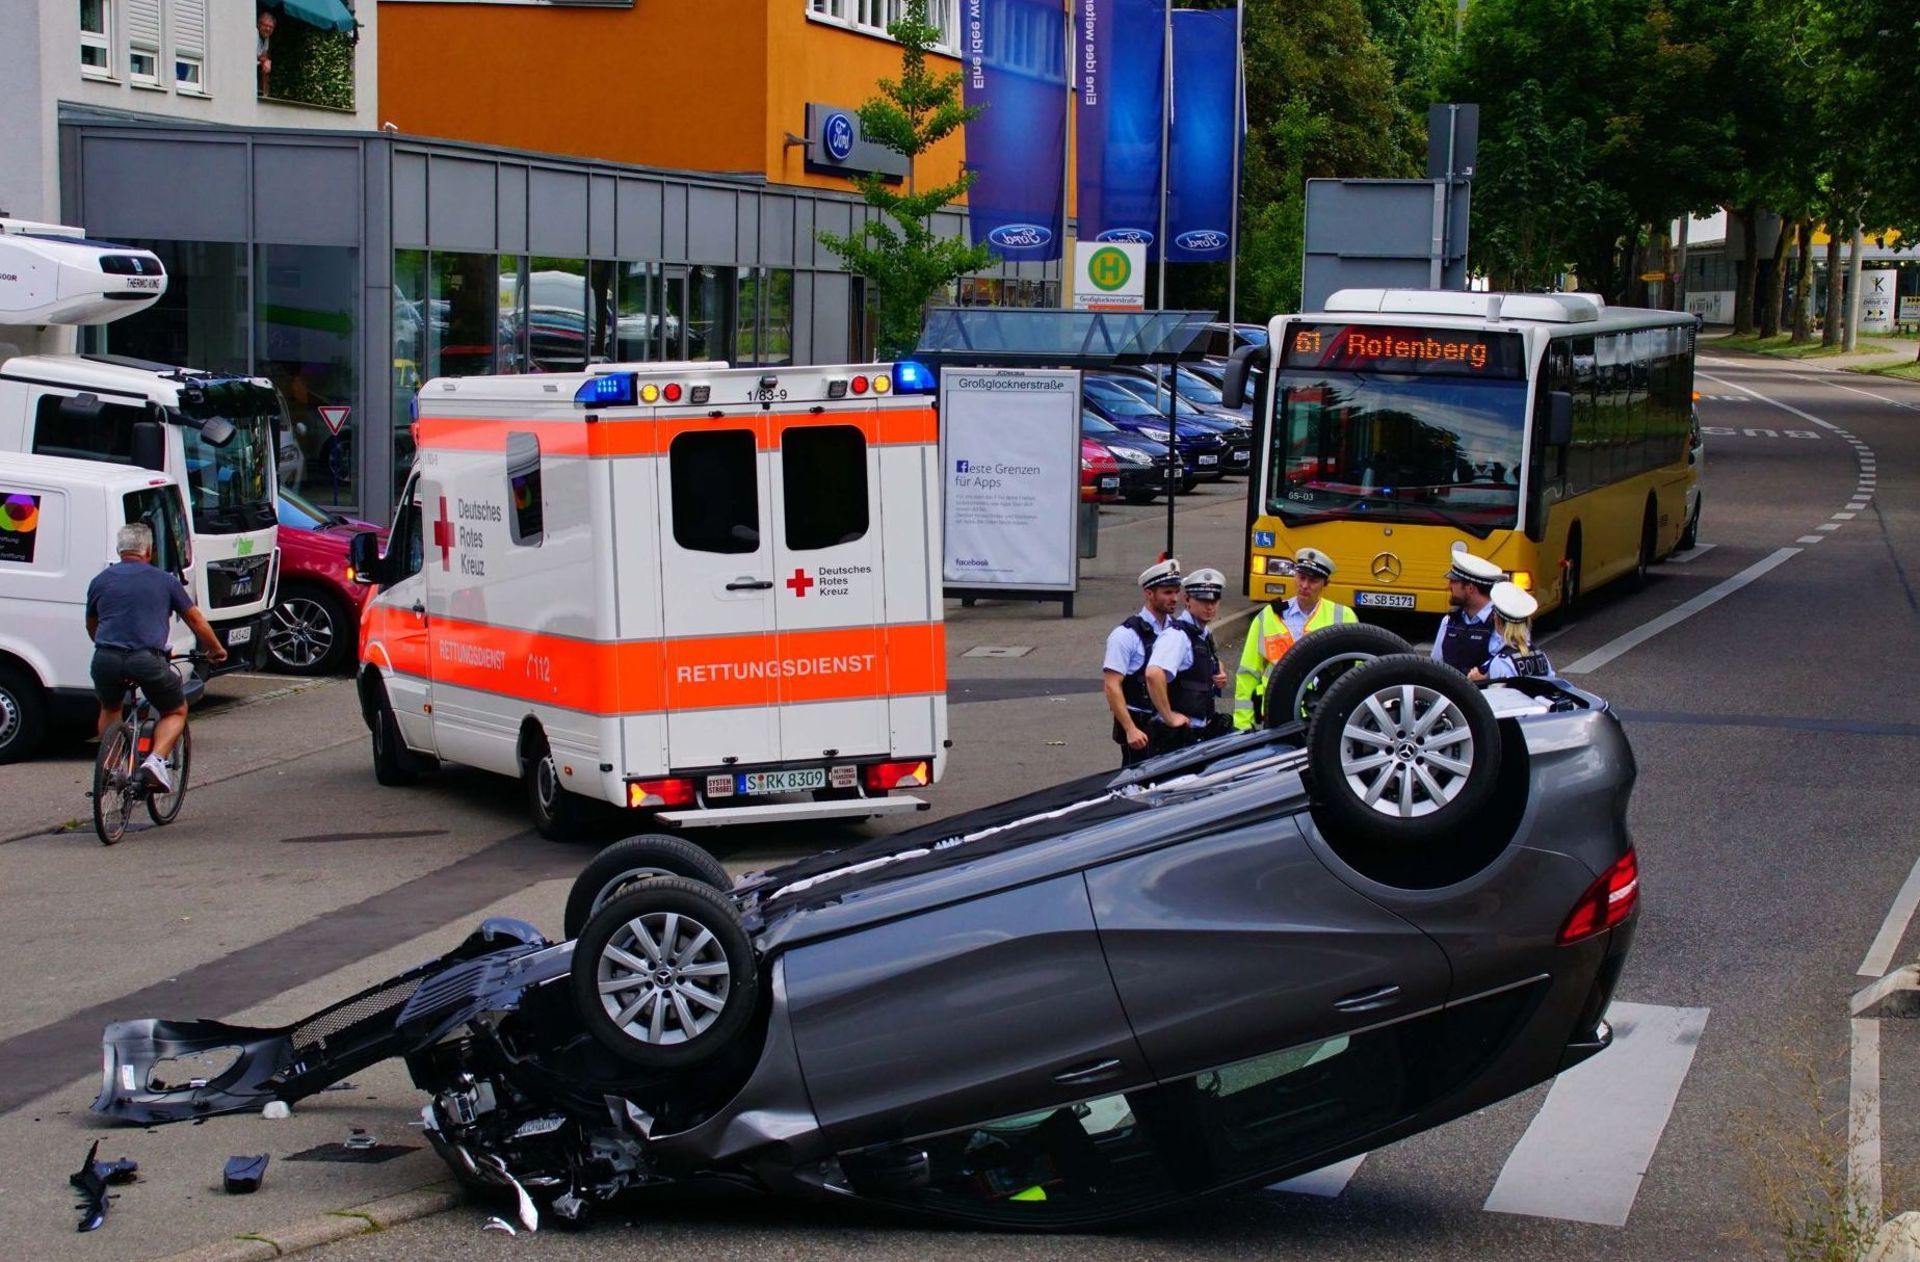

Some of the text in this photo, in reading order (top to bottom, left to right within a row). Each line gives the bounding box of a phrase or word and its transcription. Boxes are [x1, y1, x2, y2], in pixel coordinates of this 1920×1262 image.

[833, 120, 851, 150] Ford
[1100, 257, 1119, 281] H
[0, 273, 17, 281] 00R
[1295, 330, 1487, 367] 61 Rotenberg
[958, 377, 1065, 391] Großglocknerstraße
[746, 388, 788, 402] 1/83-9
[995, 463, 1041, 475] Grenzen
[955, 476, 1002, 489] für Apps
[458, 498, 502, 522] Deutsches
[459, 526, 483, 548] Rotes
[460, 553, 485, 576] Kreuz
[955, 558, 989, 566] facebook
[819, 566, 872, 576] Deutsches
[819, 577, 849, 586] Rotes
[819, 587, 849, 596] Kreuz
[1362, 594, 1414, 607] S SB 5171
[439, 639, 506, 670] RETTUNGSDIENST
[533, 655, 551, 682] 112
[676, 653, 876, 684] RETTUNGSDIENST
[708, 778, 732, 786] SYSTEM
[747, 770, 824, 790] S RK 8309
[708, 785, 733, 793] STROBEL
